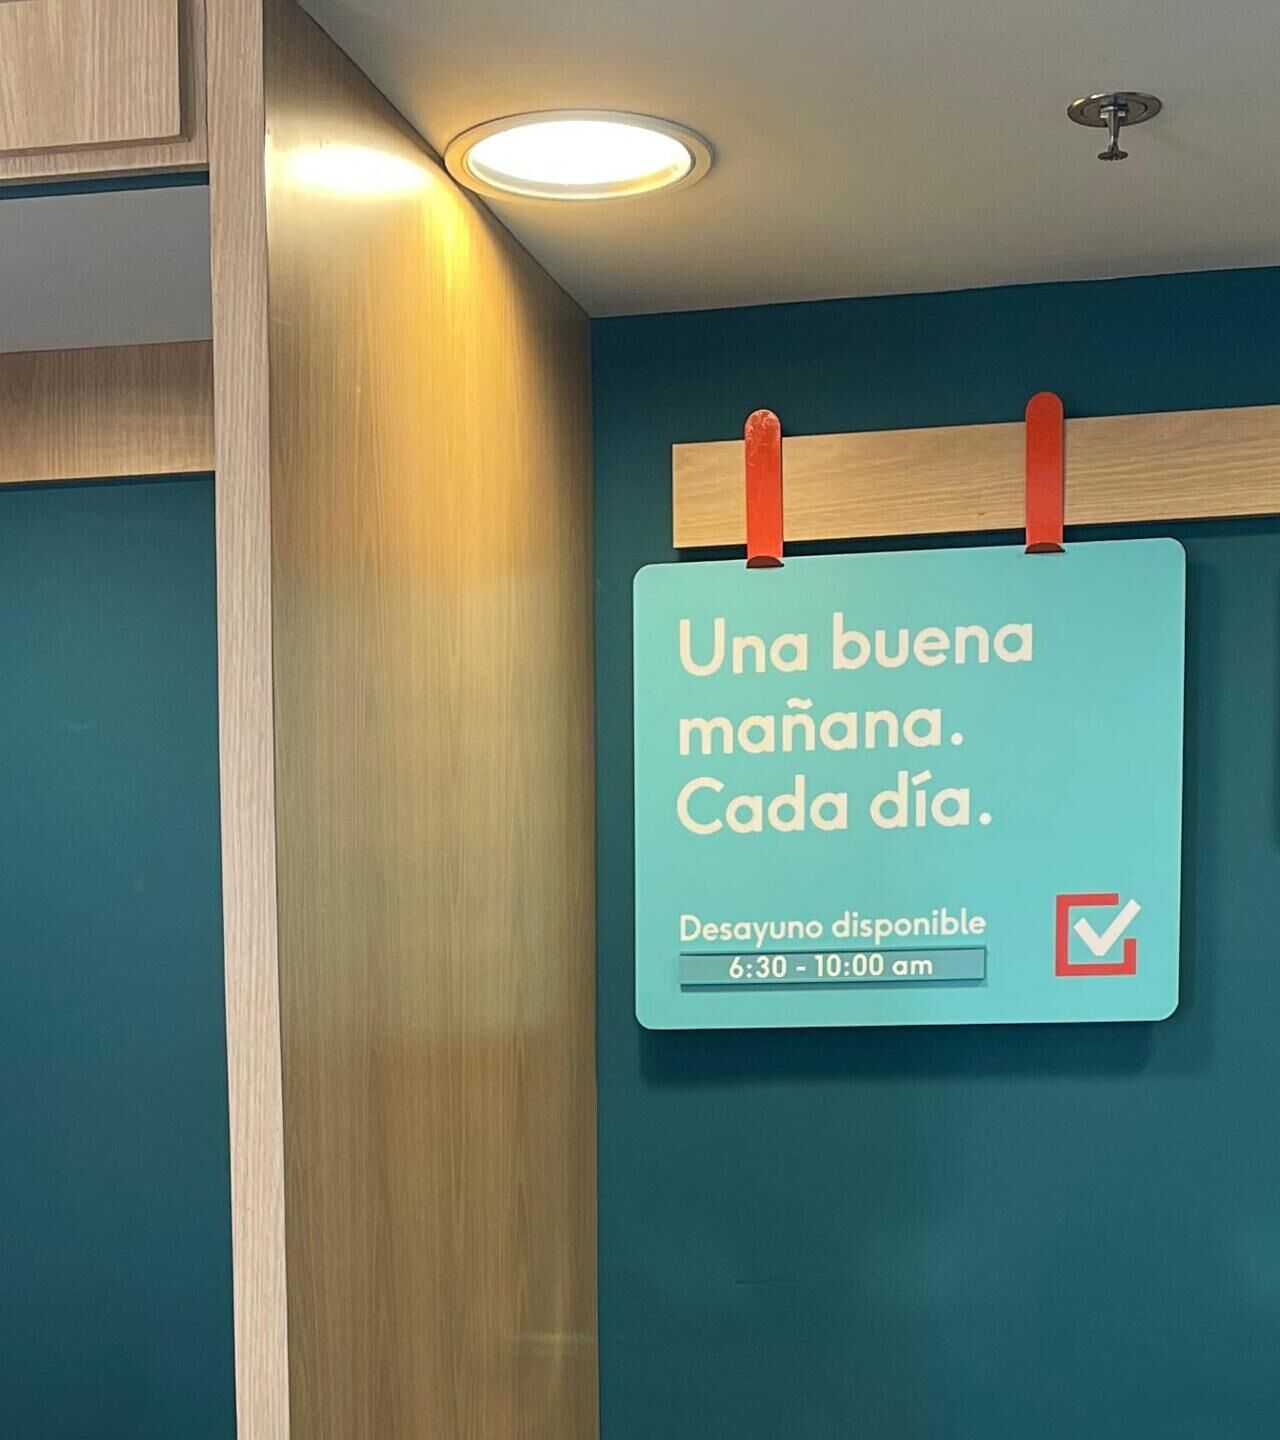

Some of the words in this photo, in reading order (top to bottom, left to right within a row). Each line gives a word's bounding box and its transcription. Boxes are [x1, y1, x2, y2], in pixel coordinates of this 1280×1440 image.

[678, 617, 809, 677] Una
[832, 611, 1033, 670] buena
[678, 697, 965, 756] mañana.
[676, 773, 849, 836] Cada
[869, 769, 993, 830] día.
[680, 914, 823, 949] Desayuno
[831, 907, 987, 946] disponible
[728, 955, 787, 979] 6:30
[814, 953, 884, 977] 10:00
[892, 957, 934, 976] am
